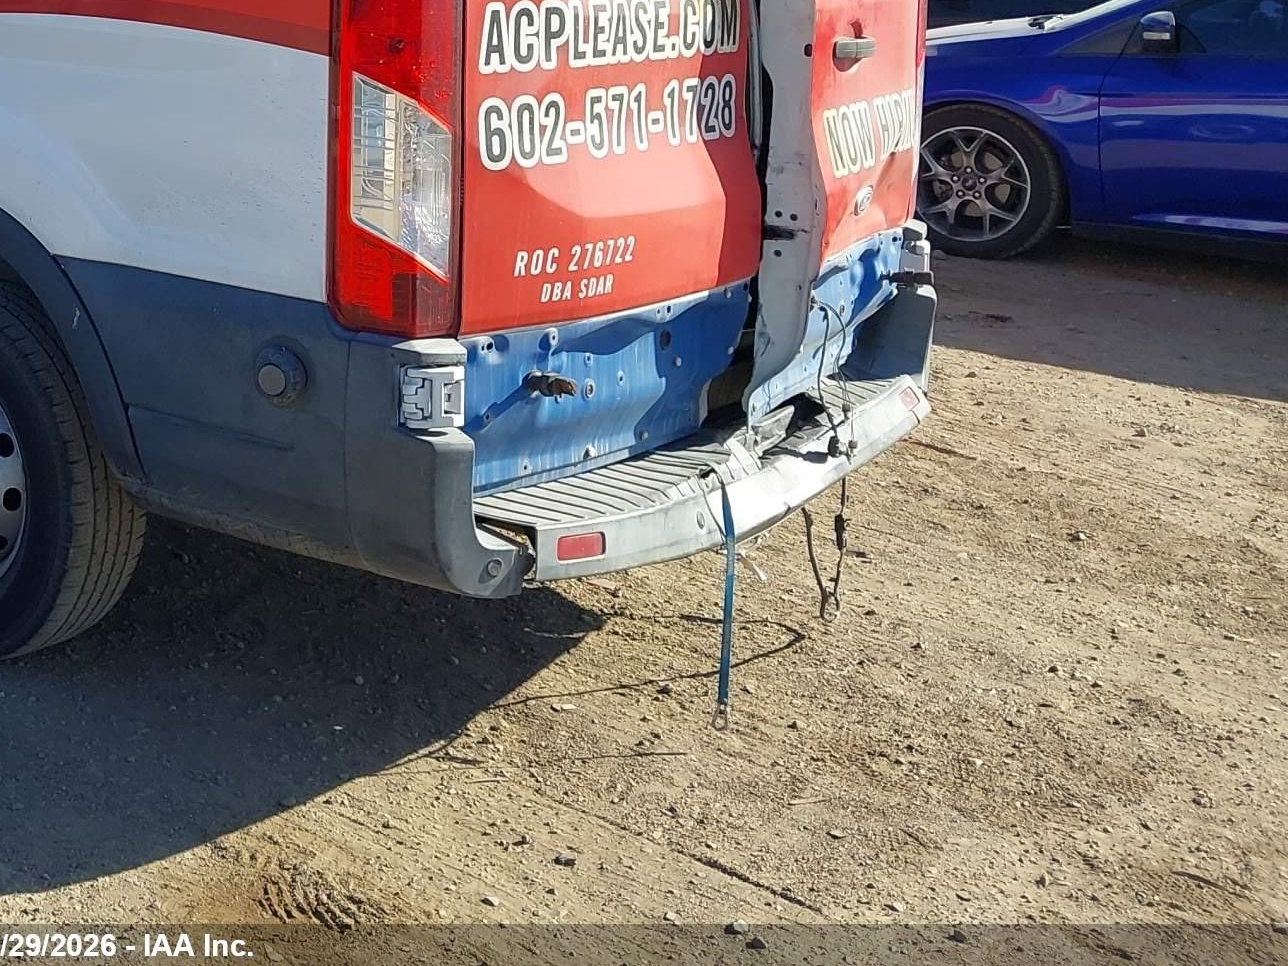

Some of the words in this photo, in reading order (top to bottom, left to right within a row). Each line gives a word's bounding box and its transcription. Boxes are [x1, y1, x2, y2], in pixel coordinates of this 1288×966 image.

[479, 75, 736, 169] 602-571-1728
[823, 100, 876, 178] NOW
[514, 248, 560, 277] ROC
[568, 236, 636, 273] 276722
[540, 280, 573, 304] DBA
[579, 274, 614, 300] SDAR
